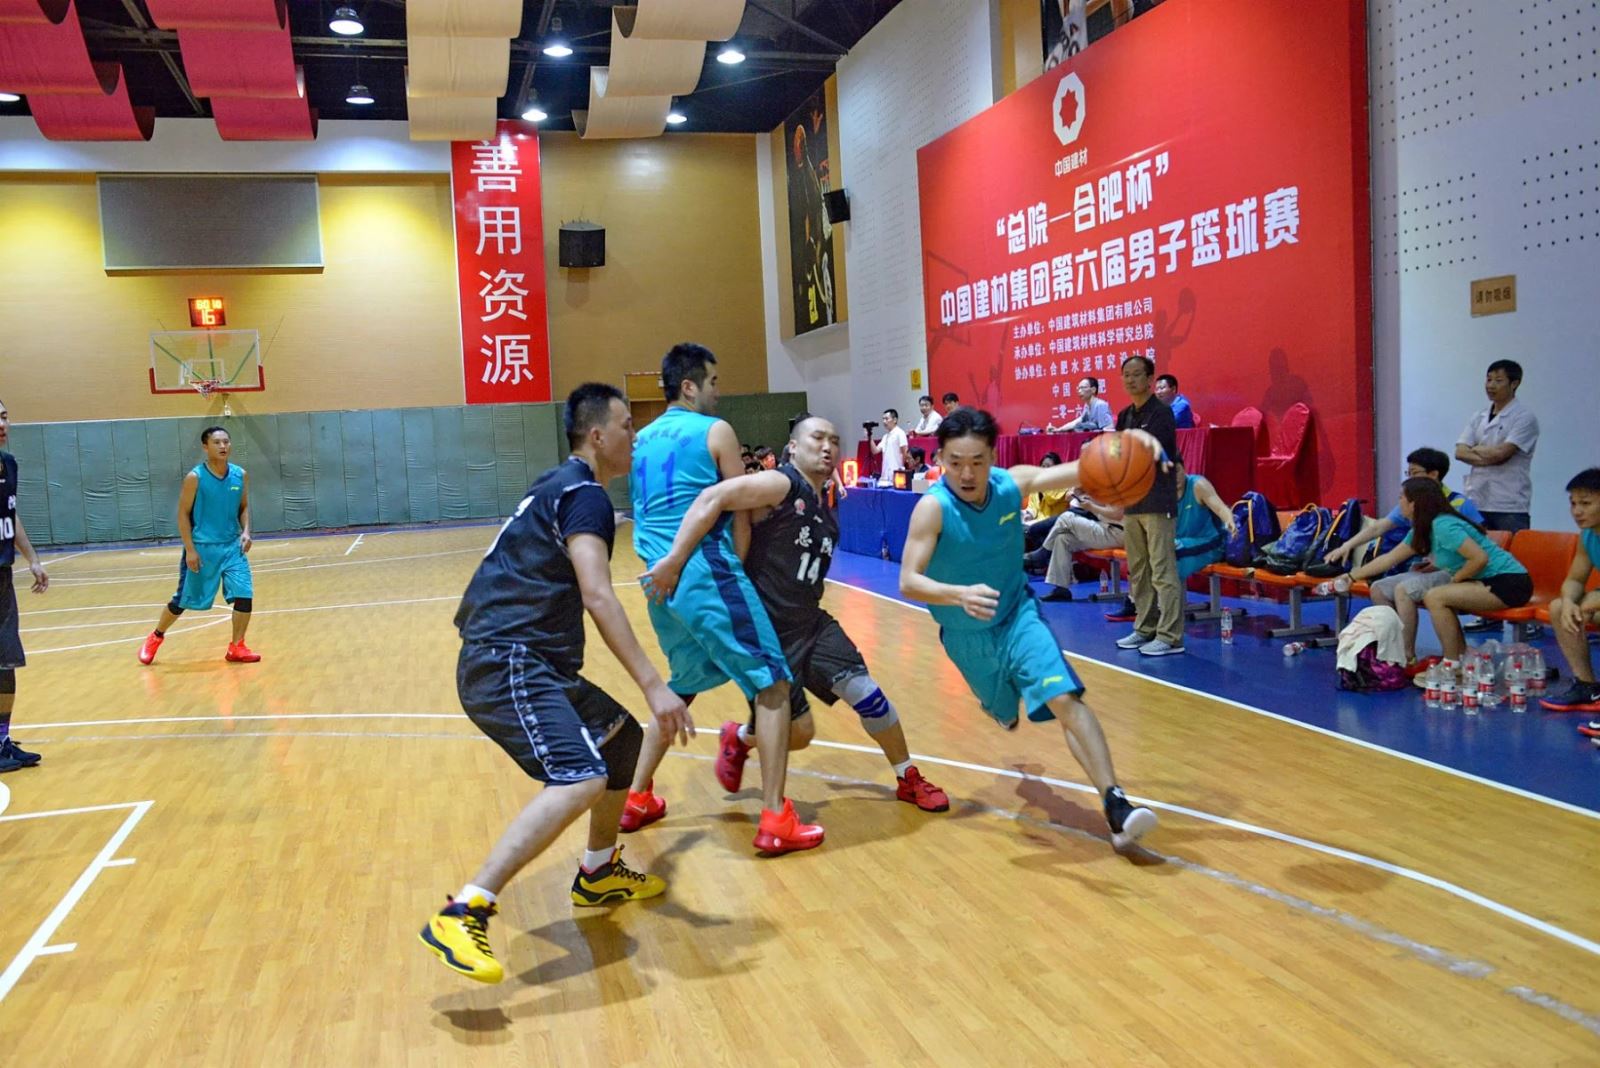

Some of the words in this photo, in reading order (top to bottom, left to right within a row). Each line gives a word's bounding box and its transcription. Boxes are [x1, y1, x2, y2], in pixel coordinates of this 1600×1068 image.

[1054, 148, 1089, 177] 中国建材
[470, 140, 534, 384] 善用资源
[940, 186, 1300, 326] 中国建材集团第六届男子篮球赛
[637, 451, 675, 514] 11
[796, 551, 821, 585] 14
